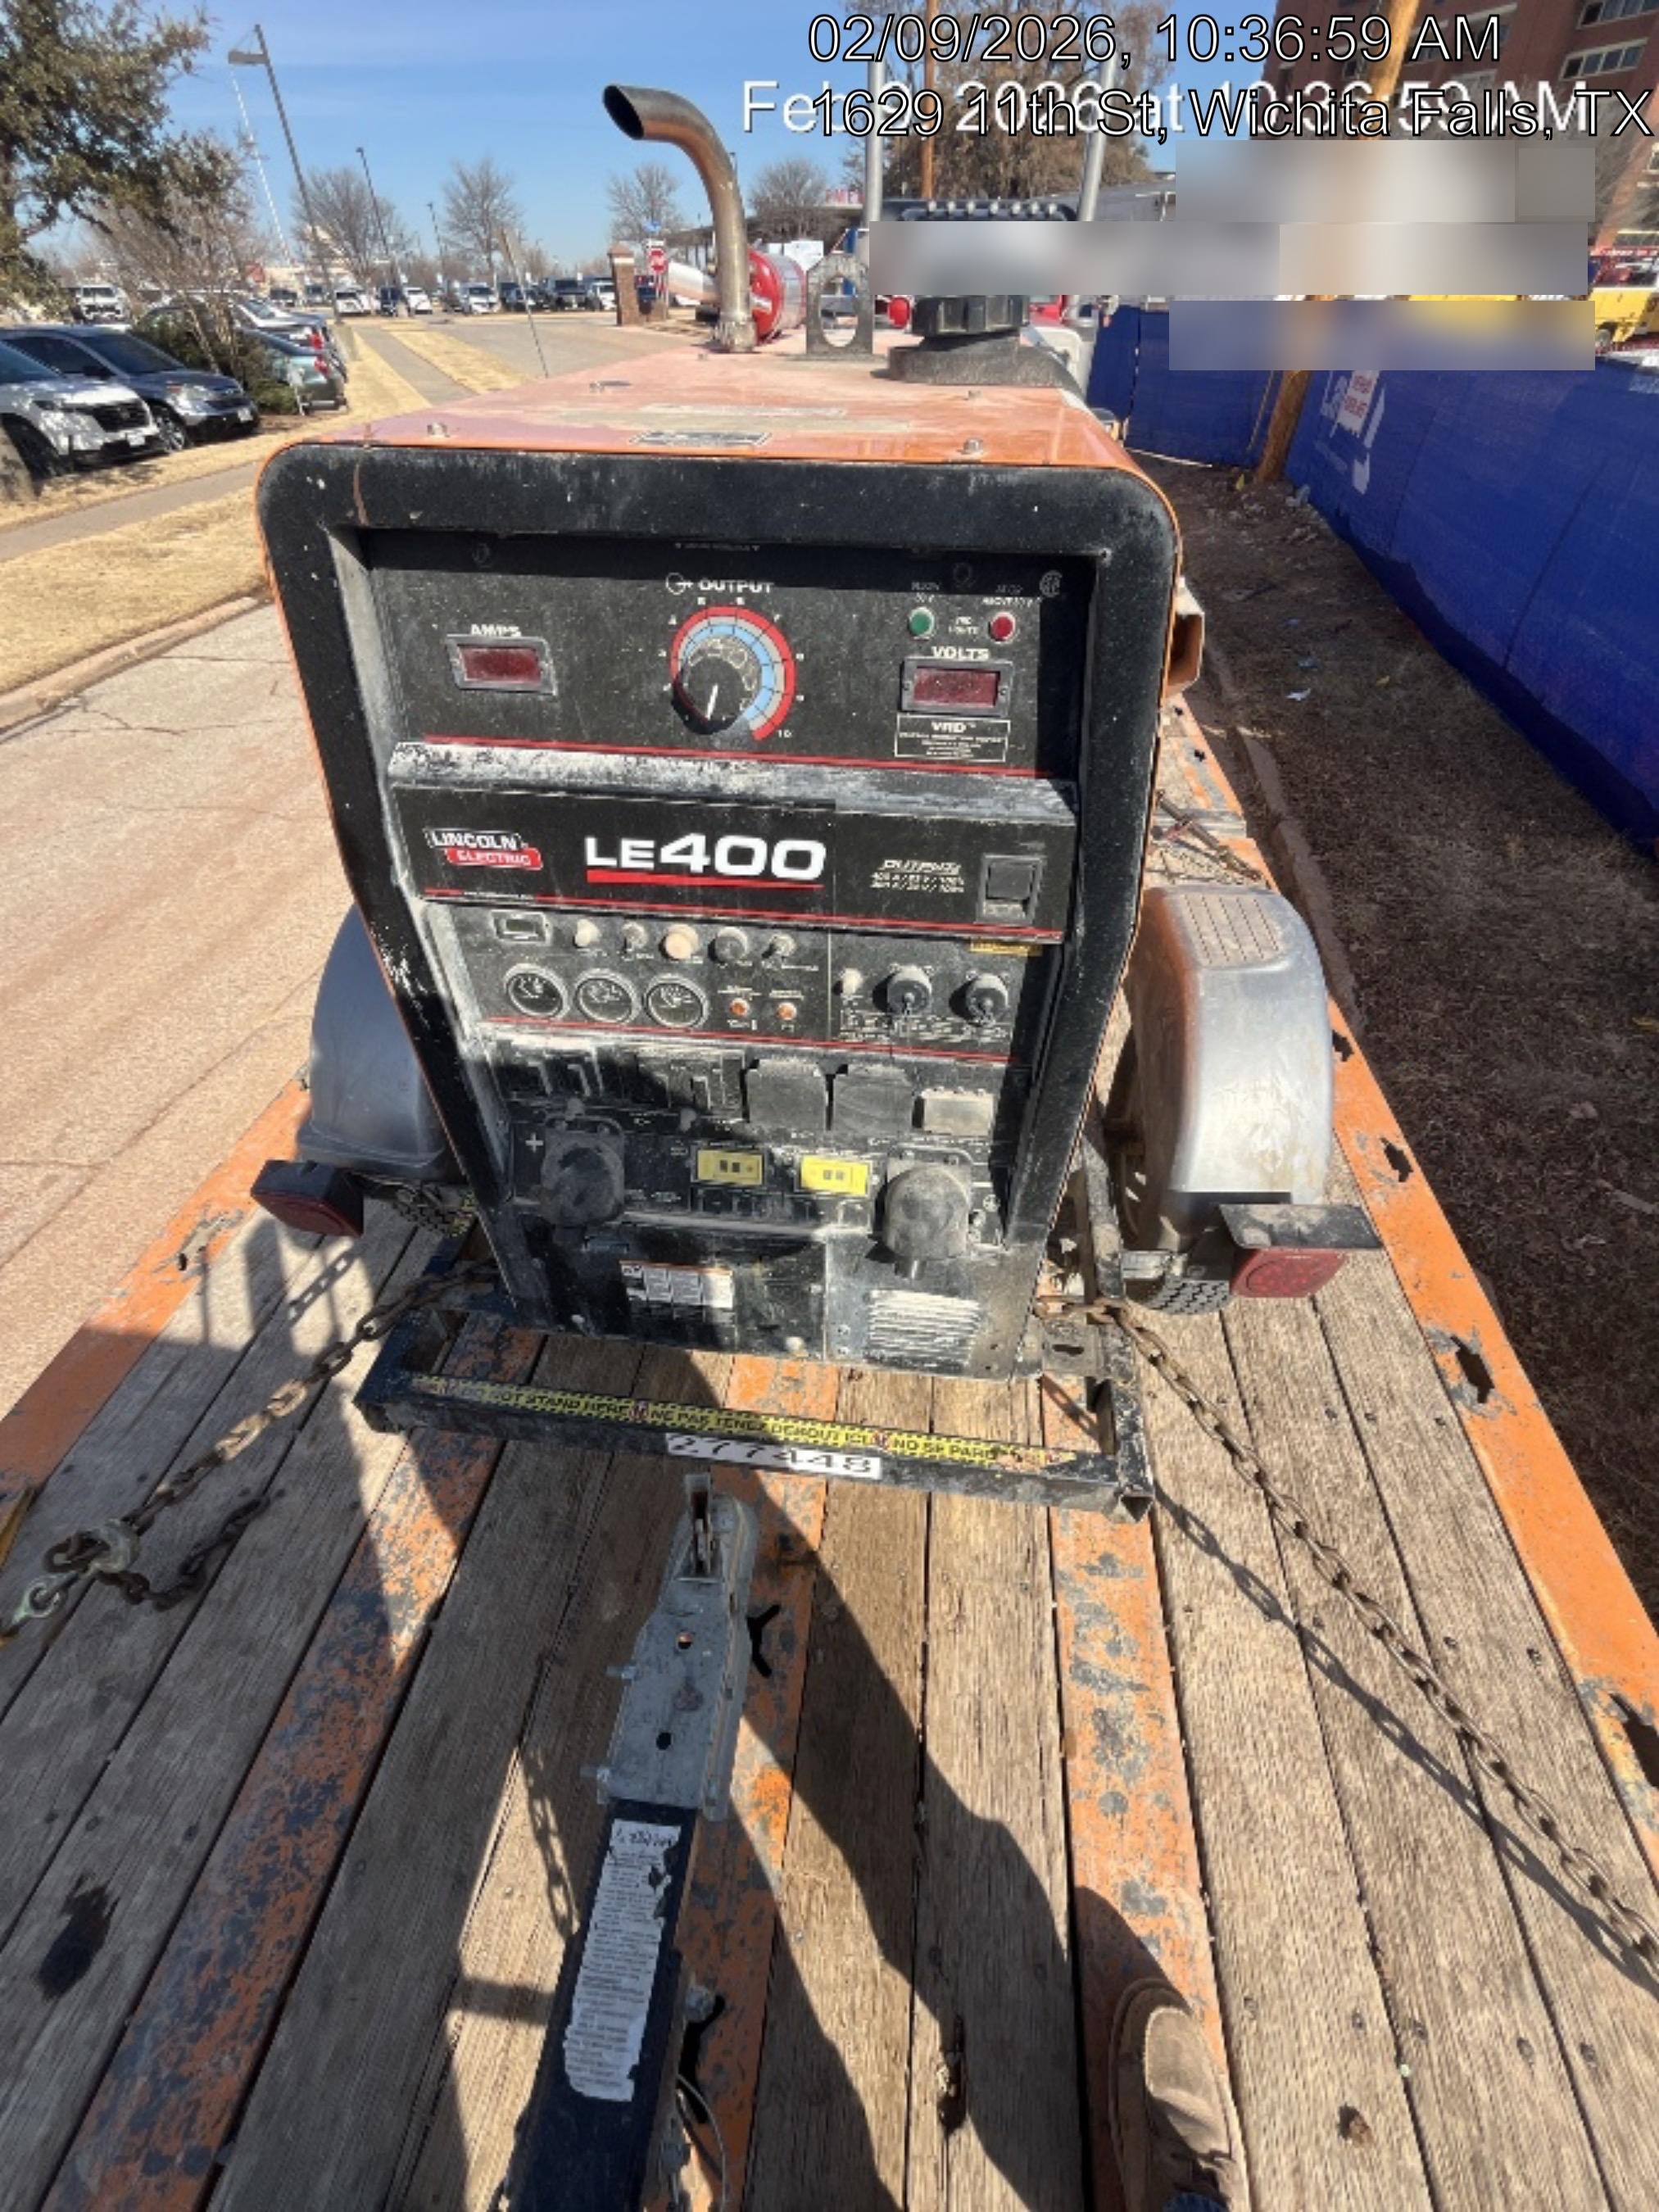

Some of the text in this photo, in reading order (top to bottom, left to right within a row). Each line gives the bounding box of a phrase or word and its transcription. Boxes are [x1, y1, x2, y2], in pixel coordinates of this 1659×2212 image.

[698, 578, 774, 593] OUTPUT
[470, 623, 522, 637] AMPS
[931, 646, 990, 661] VOLTS
[431, 830, 518, 850] LINCOLN
[456, 850, 532, 866] ELECTRIC
[584, 833, 827, 881] LE400
[525, 1394, 581, 1410] STAND
[582, 1401, 630, 1417] HERE
[893, 1437, 919, 1452] NO
